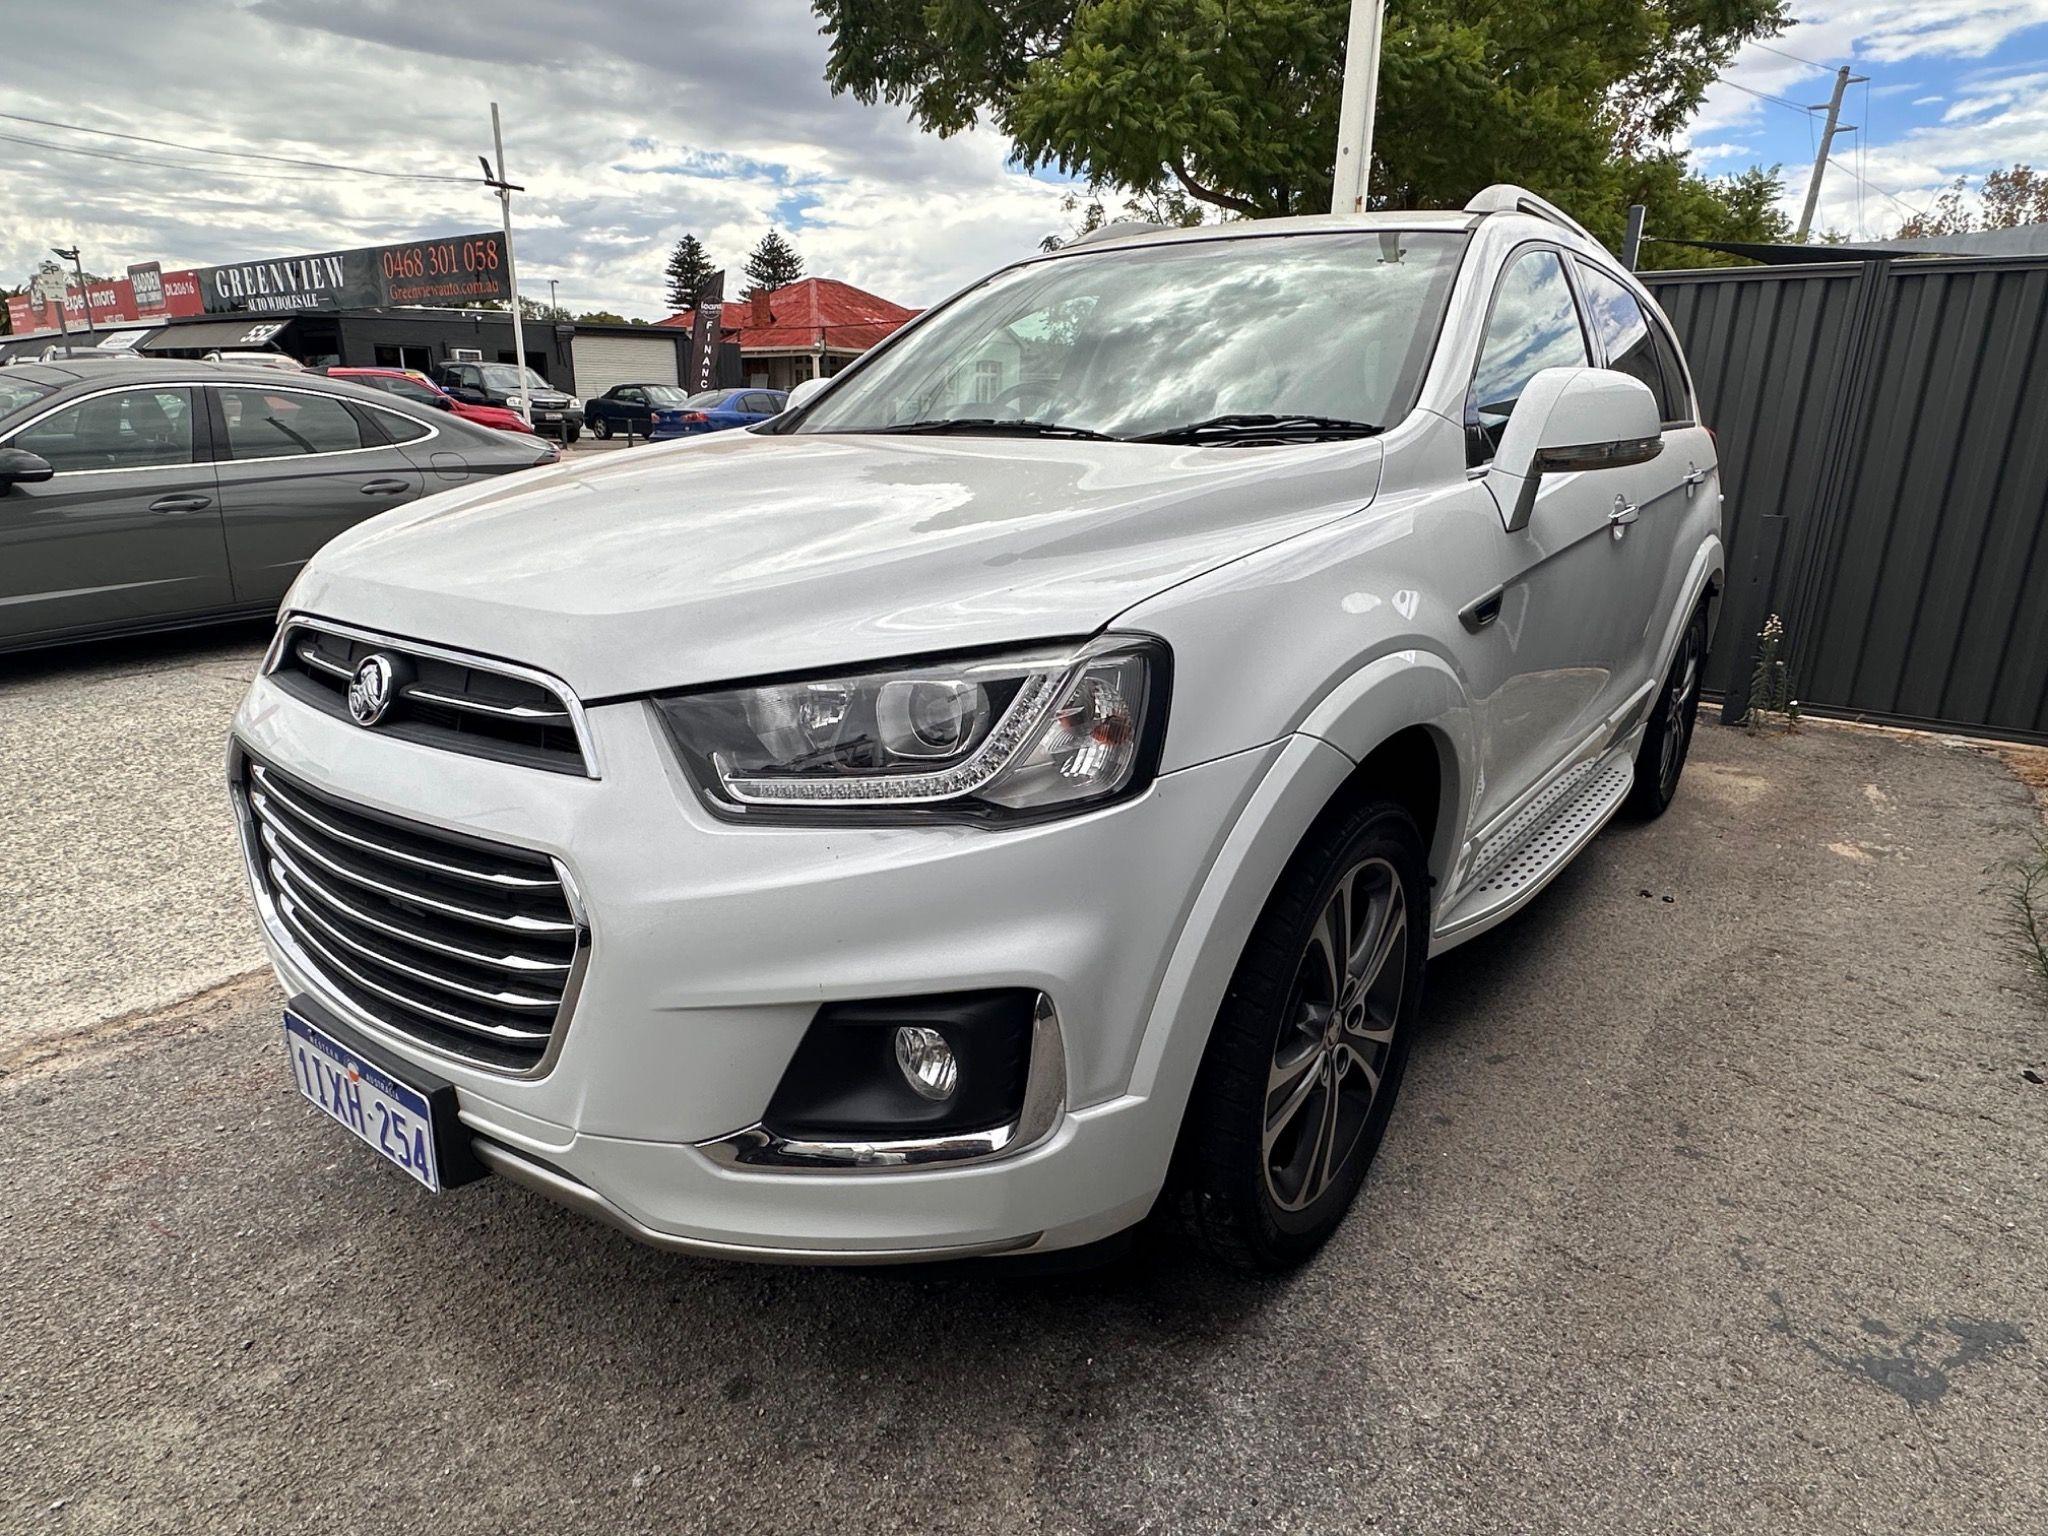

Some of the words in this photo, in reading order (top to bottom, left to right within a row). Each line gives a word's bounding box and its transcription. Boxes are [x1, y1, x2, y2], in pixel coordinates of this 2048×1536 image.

[41, 264, 60, 275] 2P
[383, 248, 424, 279] 0468
[428, 244, 459, 275] 301
[463, 239, 499, 272] 058
[215, 255, 344, 298] GREENVIEW
[64, 289, 93, 316] expet
[91, 289, 116, 307] more
[247, 297, 268, 312] AUTO
[267, 293, 319, 311] WHOLESALE
[240, 324, 282, 342] 552
[700, 320, 714, 389] FINANC
